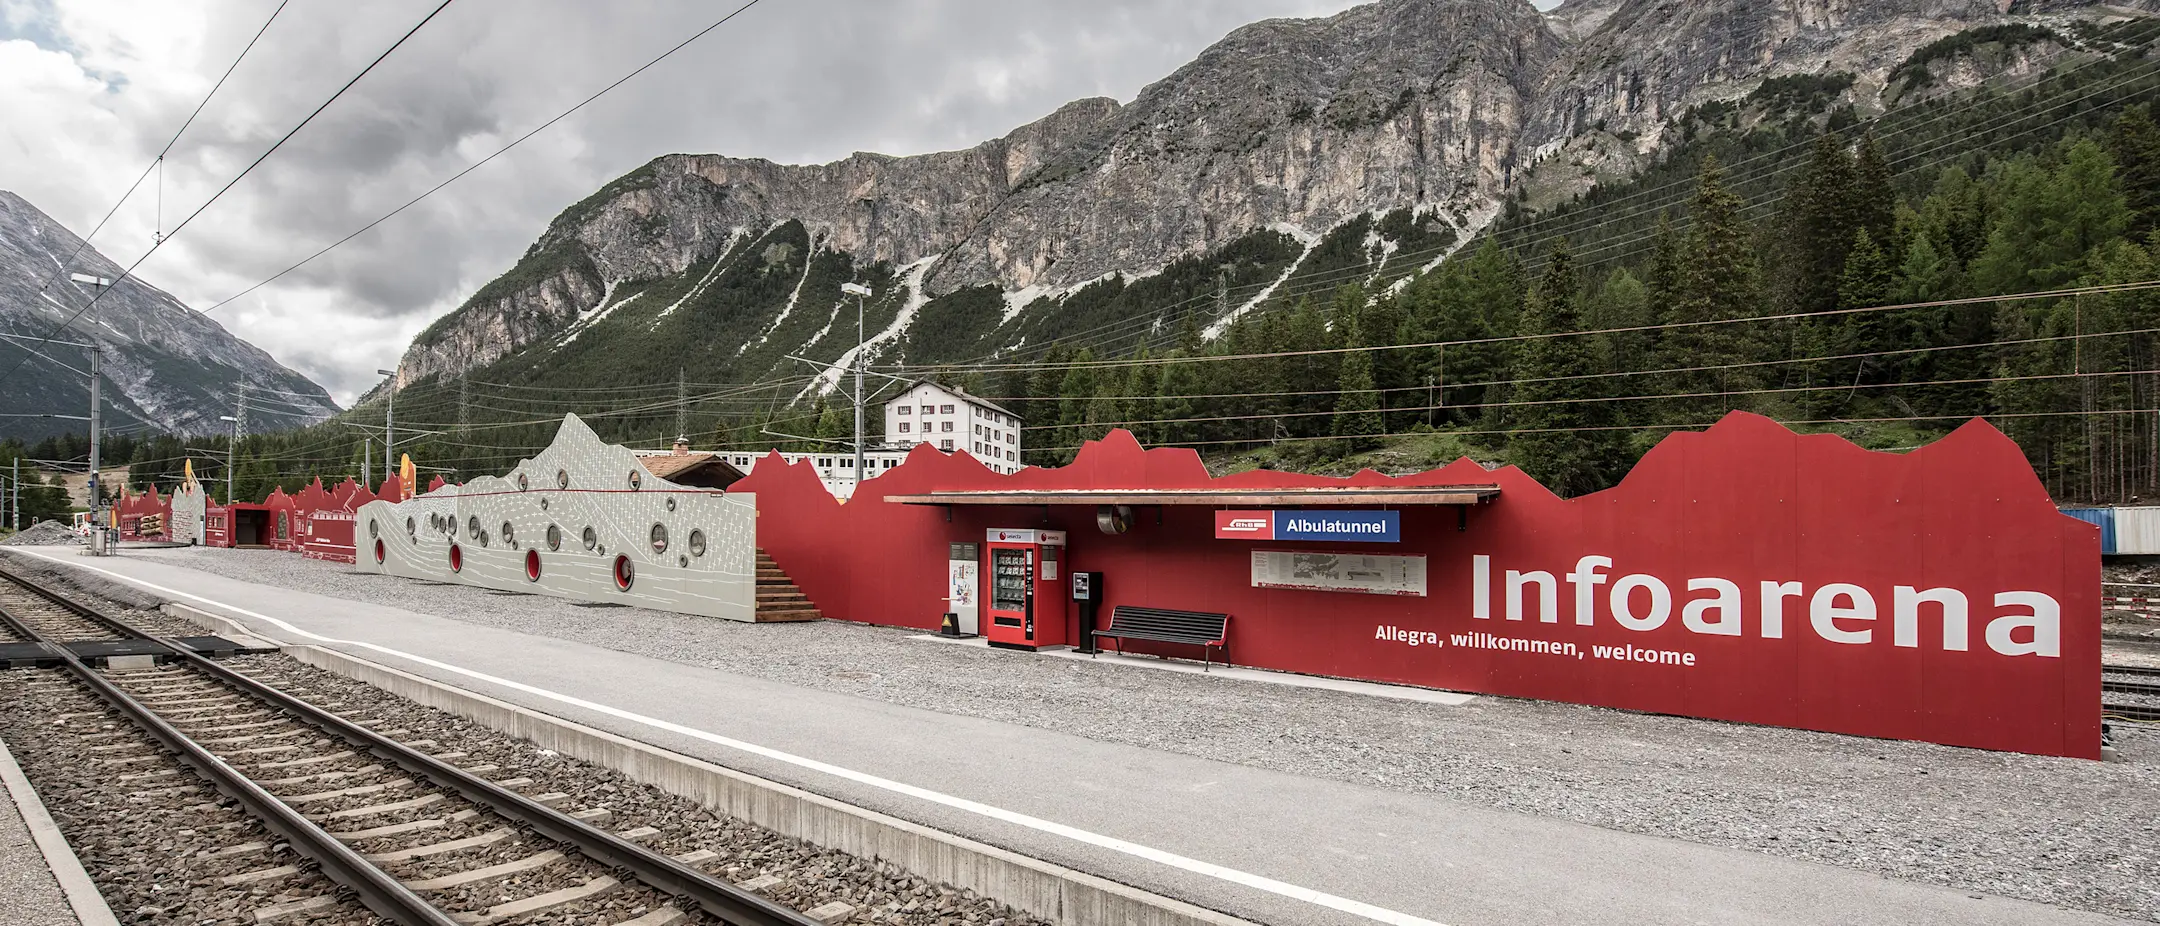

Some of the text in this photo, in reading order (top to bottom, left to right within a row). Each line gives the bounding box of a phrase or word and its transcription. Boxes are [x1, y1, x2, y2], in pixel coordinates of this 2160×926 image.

[1286, 518, 1387, 534] Albulatunnel
[1472, 554, 2061, 658] Infoarena
[1374, 624, 1697, 667] Allegra, willkommen, welcome
